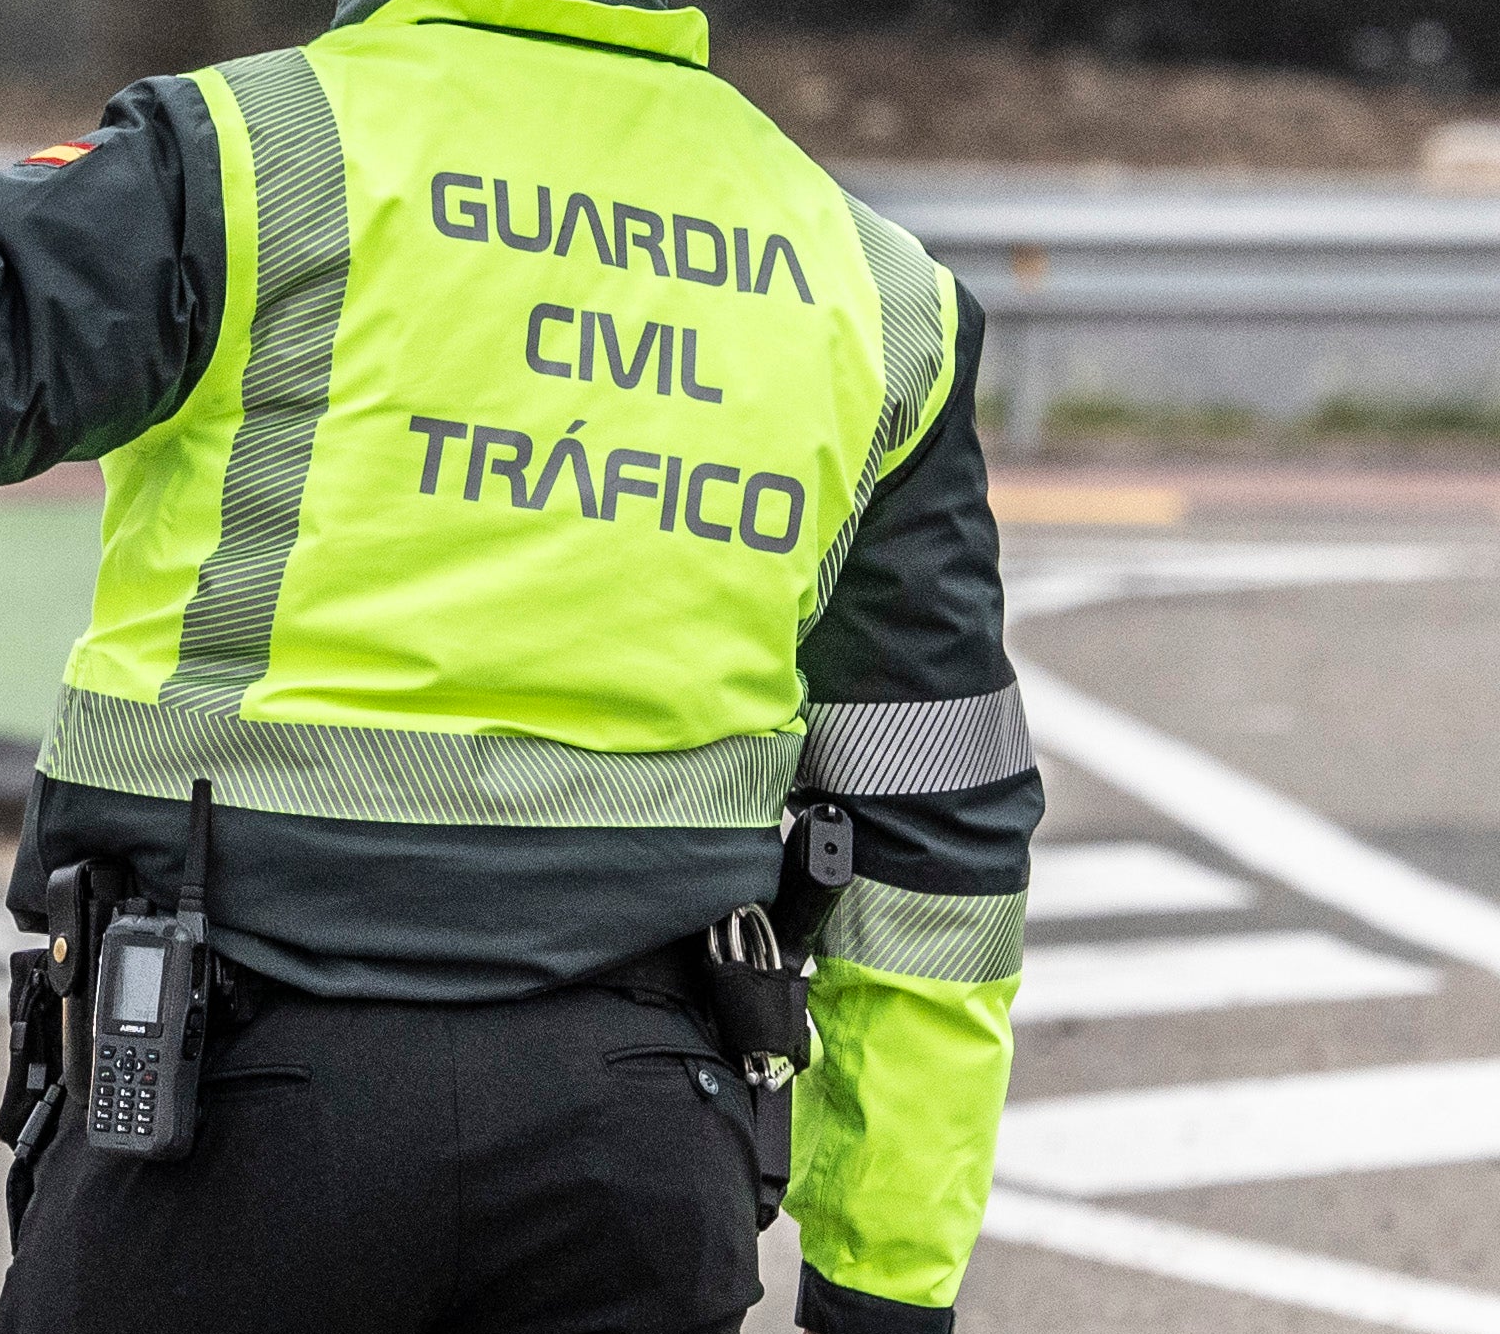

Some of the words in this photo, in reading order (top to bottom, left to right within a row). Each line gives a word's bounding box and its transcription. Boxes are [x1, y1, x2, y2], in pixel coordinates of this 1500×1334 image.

[431, 172, 813, 304] GUARDIA
[525, 303, 722, 403] CIVIL
[409, 415, 805, 554] TRÁFICO
